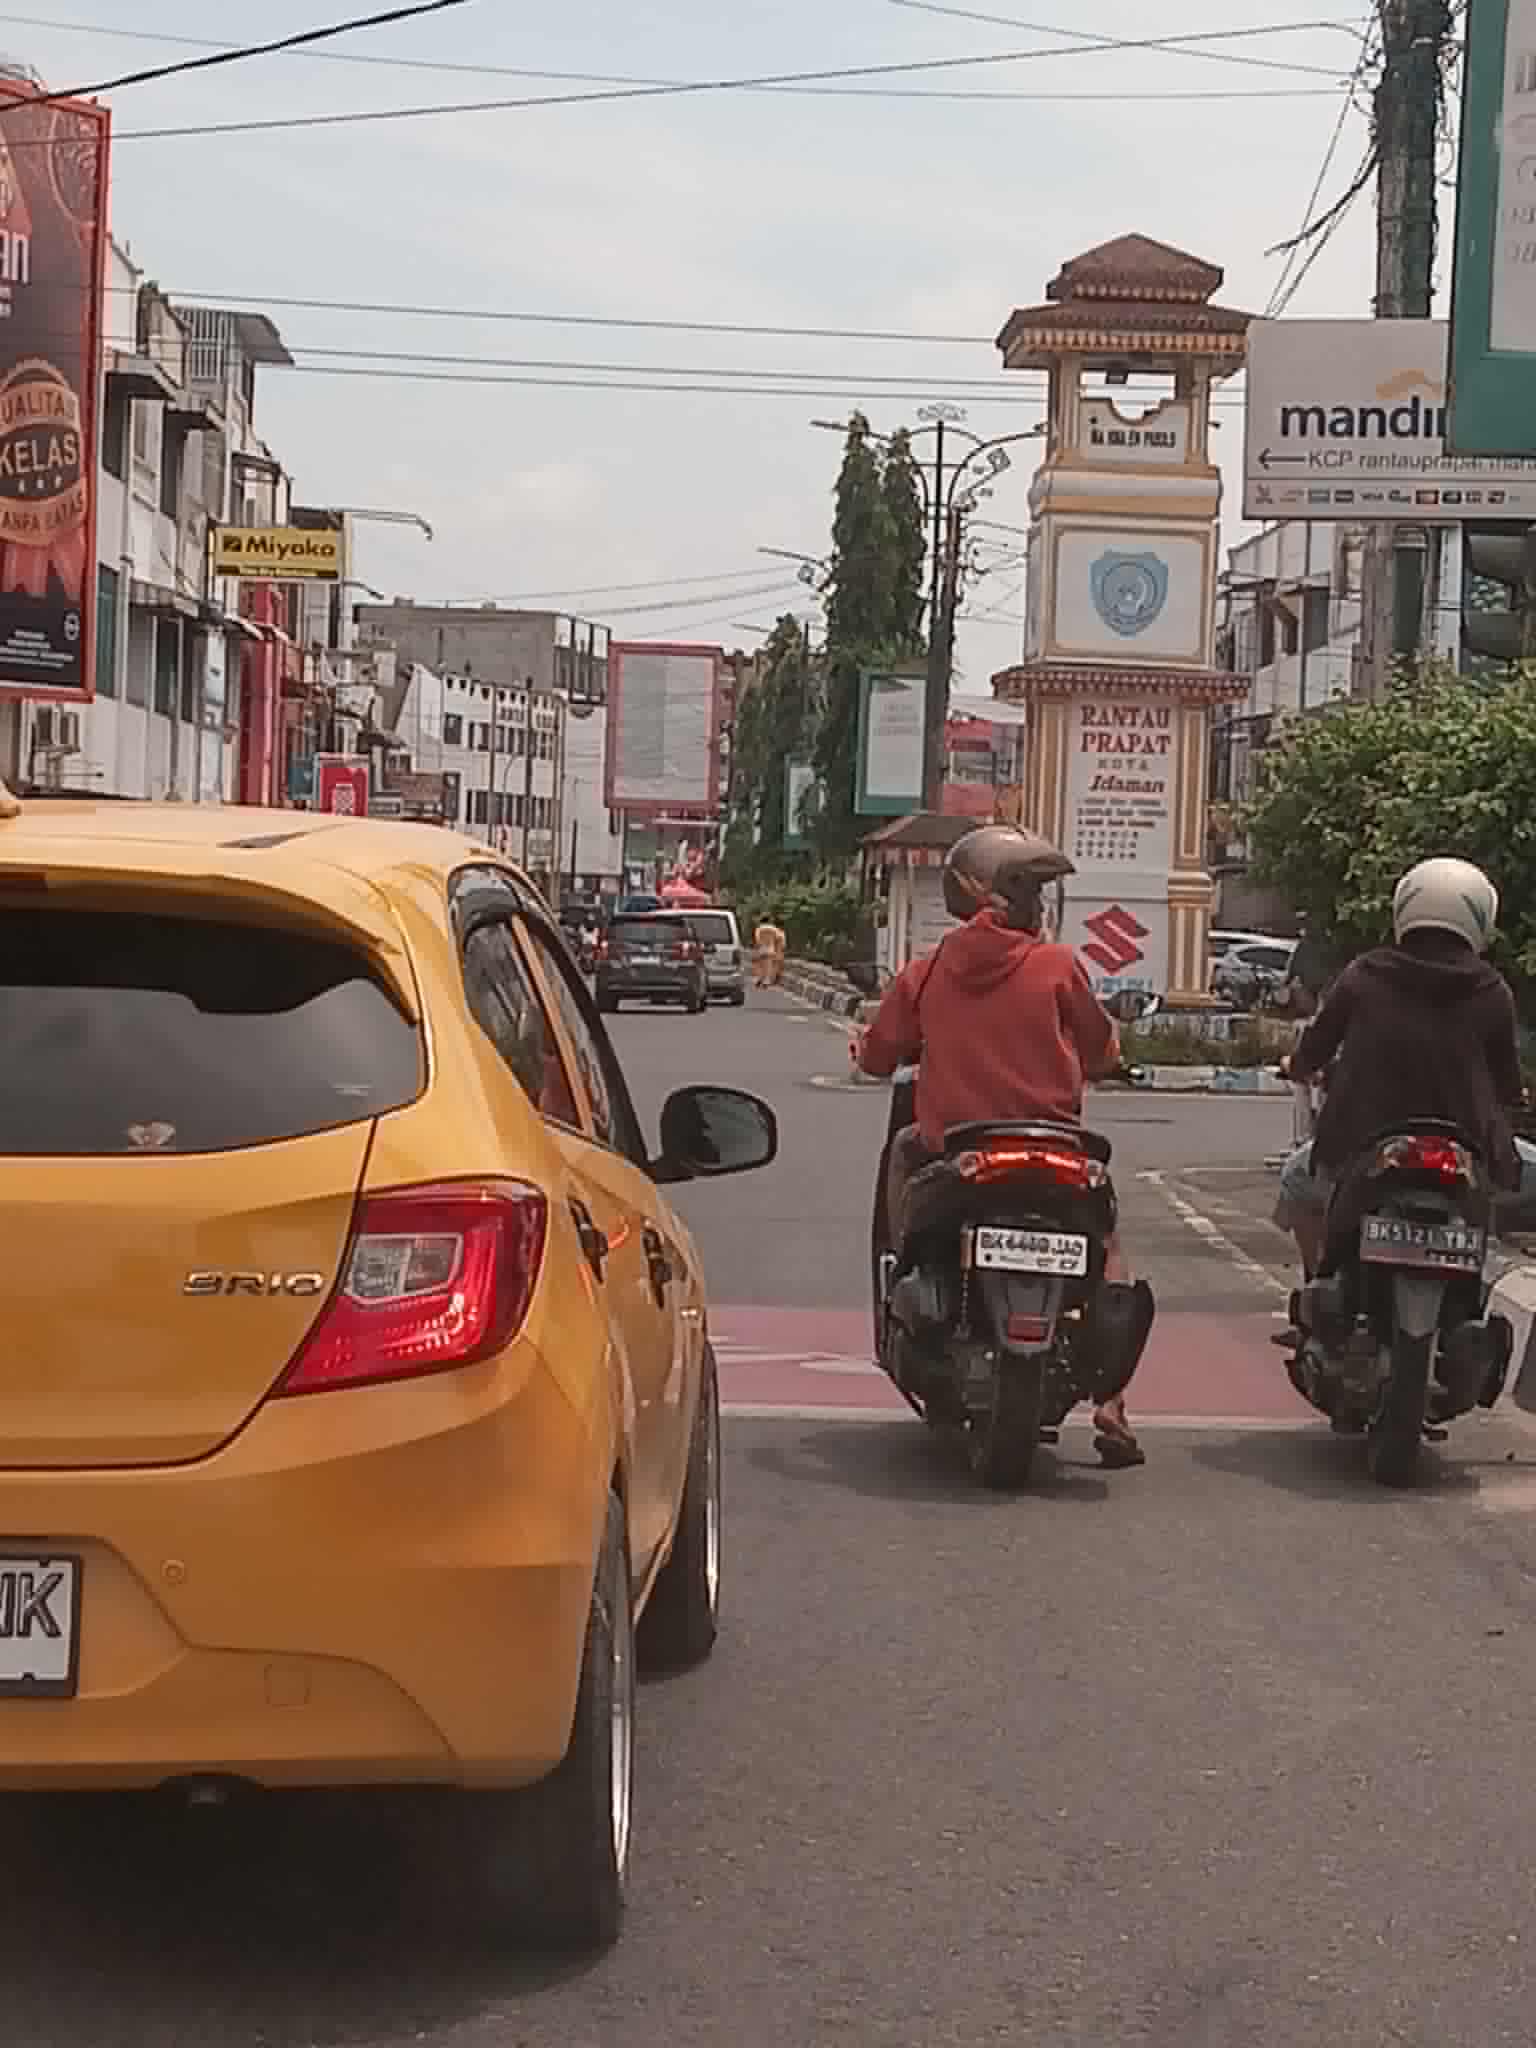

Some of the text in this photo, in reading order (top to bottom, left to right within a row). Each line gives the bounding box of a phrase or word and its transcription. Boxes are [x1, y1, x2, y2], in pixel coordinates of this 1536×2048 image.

[0, 432, 78, 477] KELAS
[1309, 450, 1353, 469] KCP
[246, 535, 336, 561] Miyako
[1079, 703, 1171, 729] RANTAU
[1080, 730, 1171, 755] PRAPAT
[184, 1271, 323, 1297] BRIO
